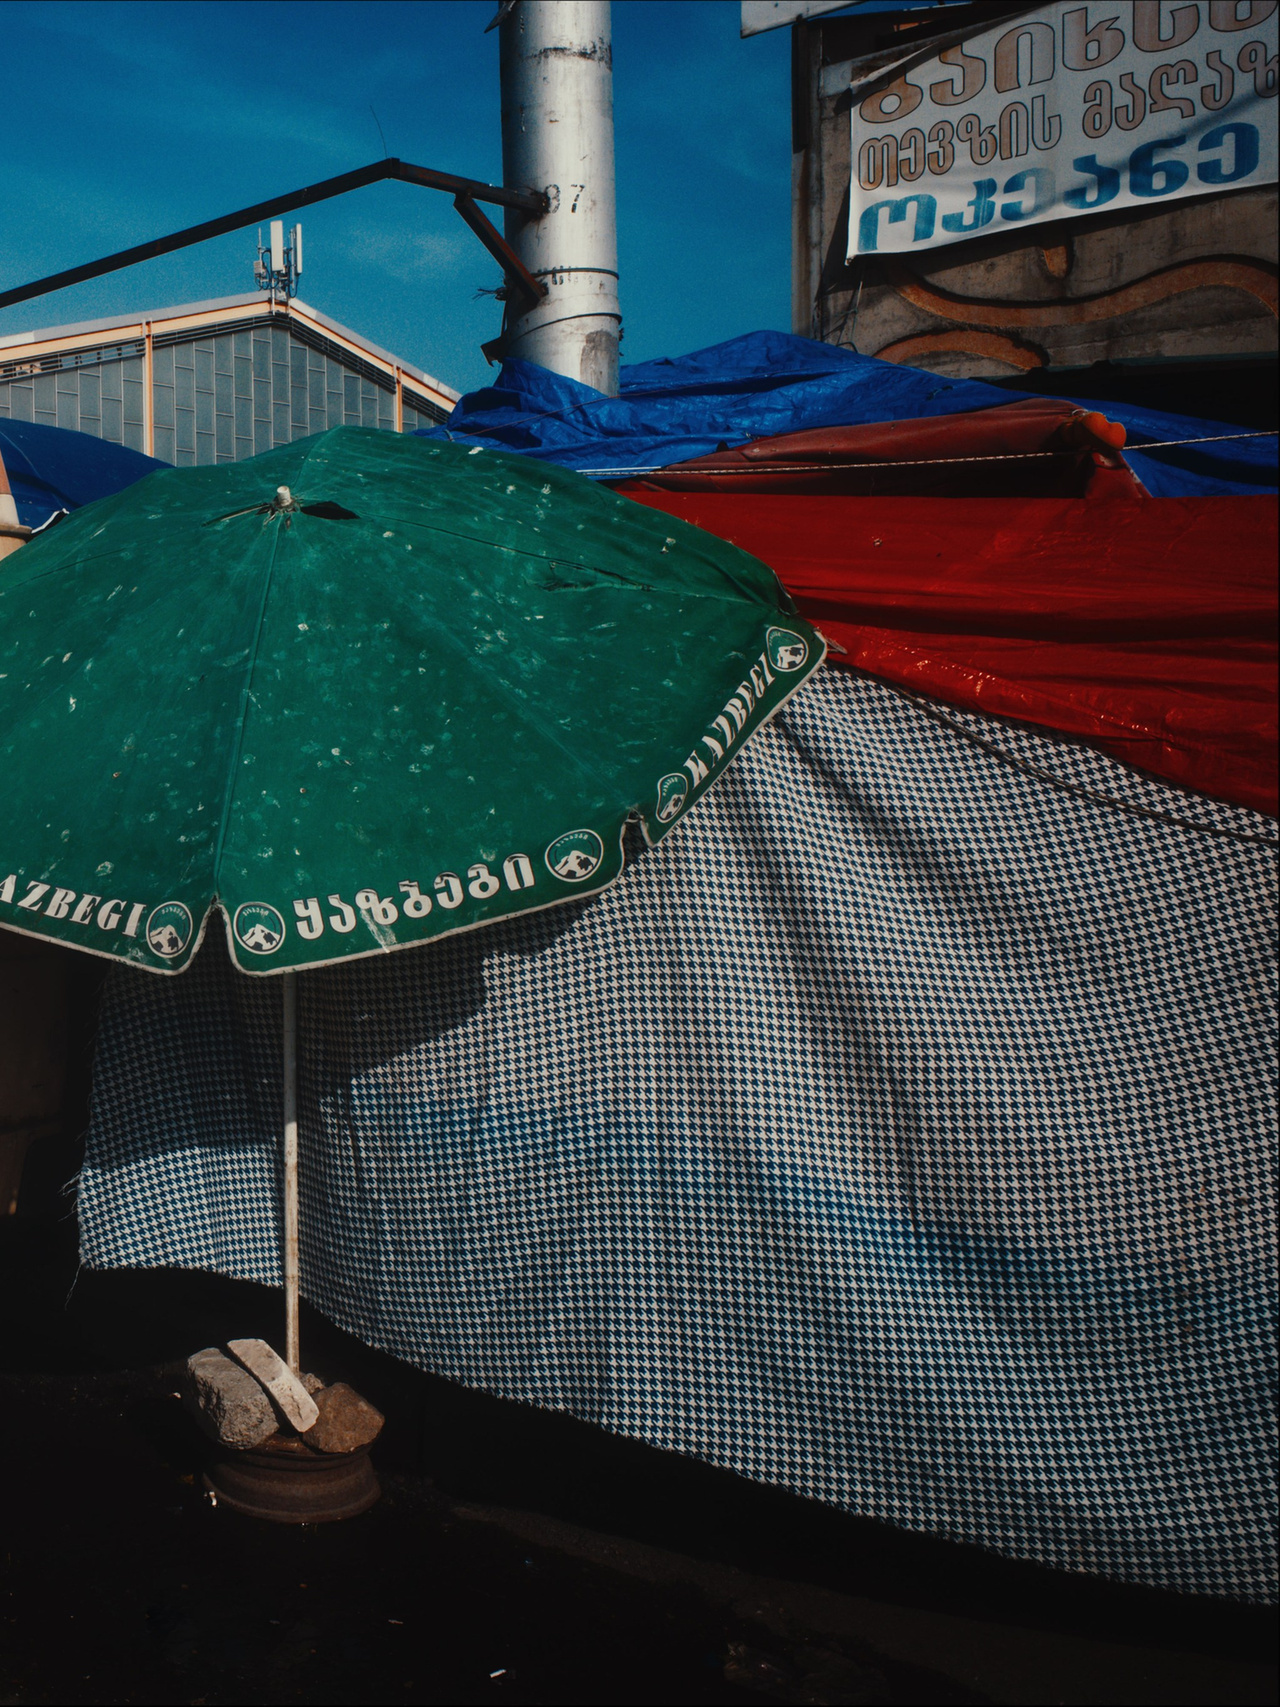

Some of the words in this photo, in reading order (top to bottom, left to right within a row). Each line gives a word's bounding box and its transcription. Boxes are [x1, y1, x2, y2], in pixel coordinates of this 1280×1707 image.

[859, 1, 1277, 124] გაიხს
[857, 121, 1260, 254] ოკეანე
[858, 95, 1062, 191] თევზის
[683, 652, 776, 790] KAZBEGI
[293, 852, 536, 940] ყაზბეგი
